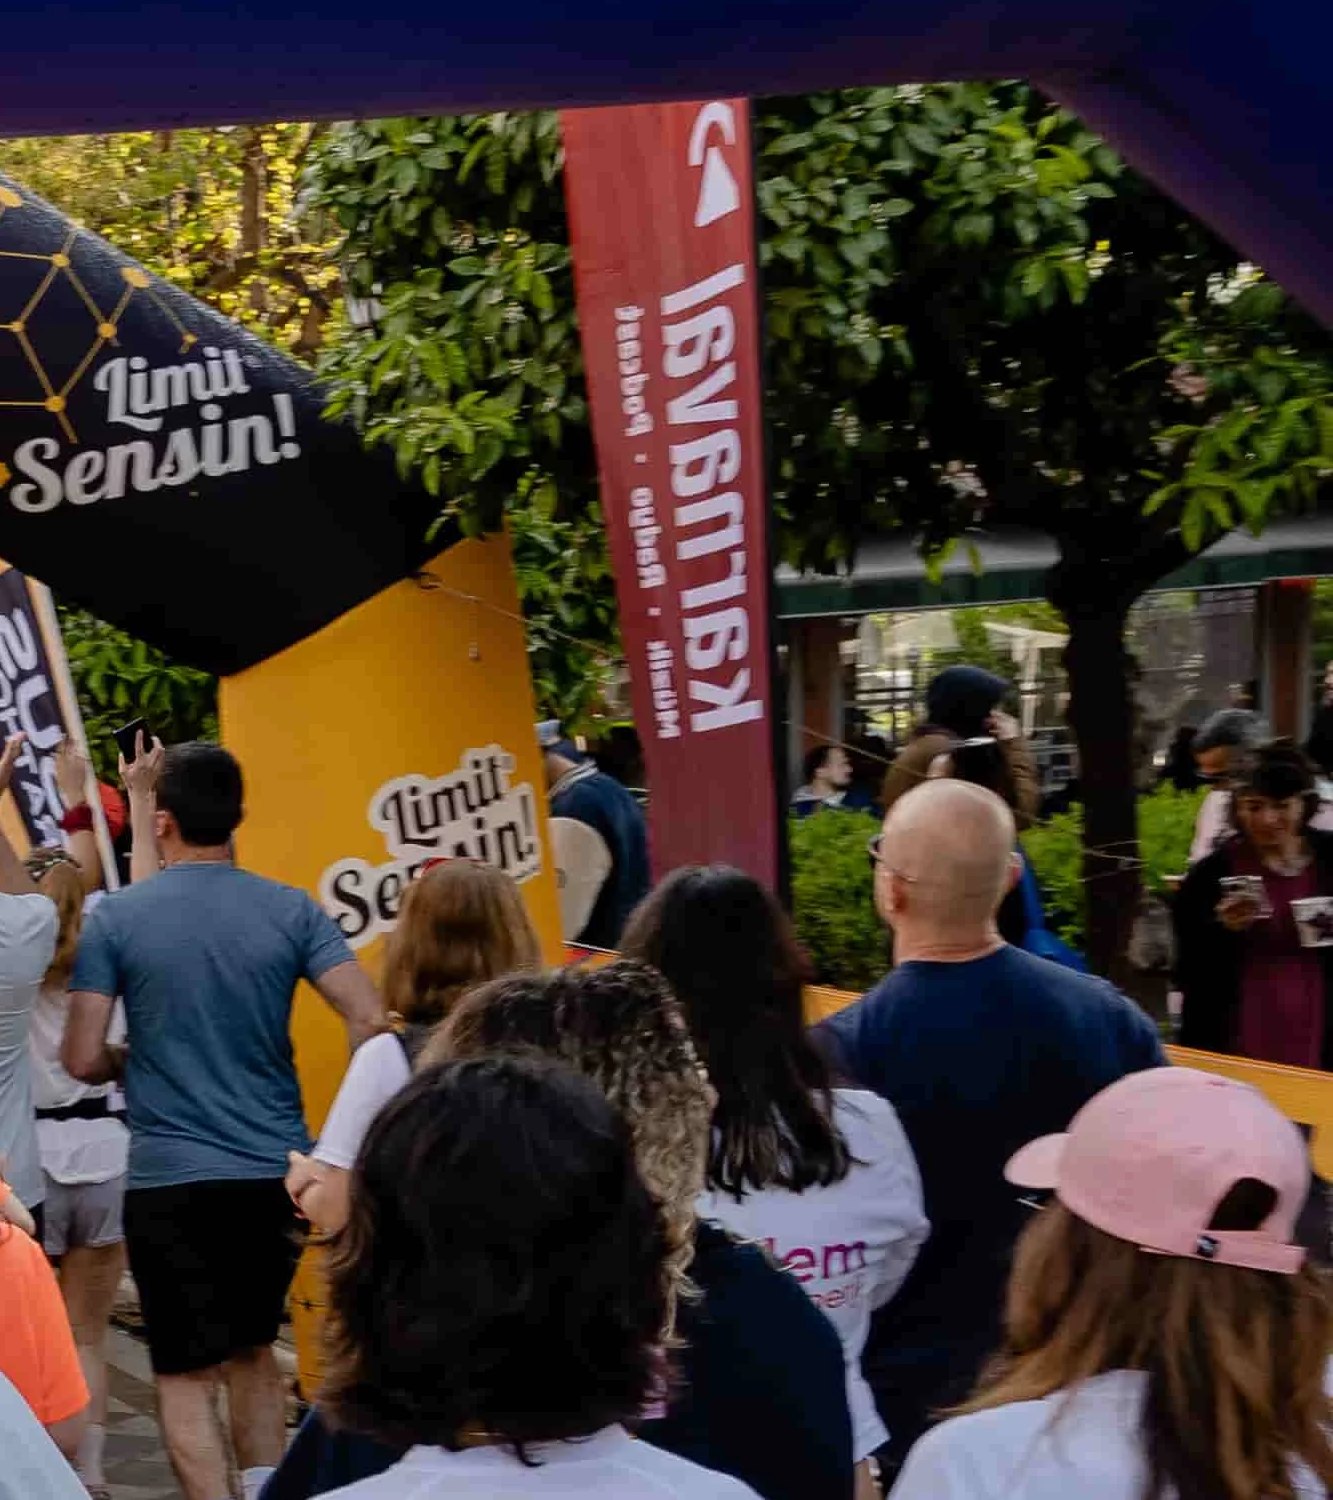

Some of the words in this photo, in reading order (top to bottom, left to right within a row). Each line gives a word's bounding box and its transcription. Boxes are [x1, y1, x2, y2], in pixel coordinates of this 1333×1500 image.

[93, 347, 251, 431] Limit
[10, 393, 301, 513] Sensin!
[382, 756, 501, 847] Limit
[333, 794, 536, 939] Sein!
